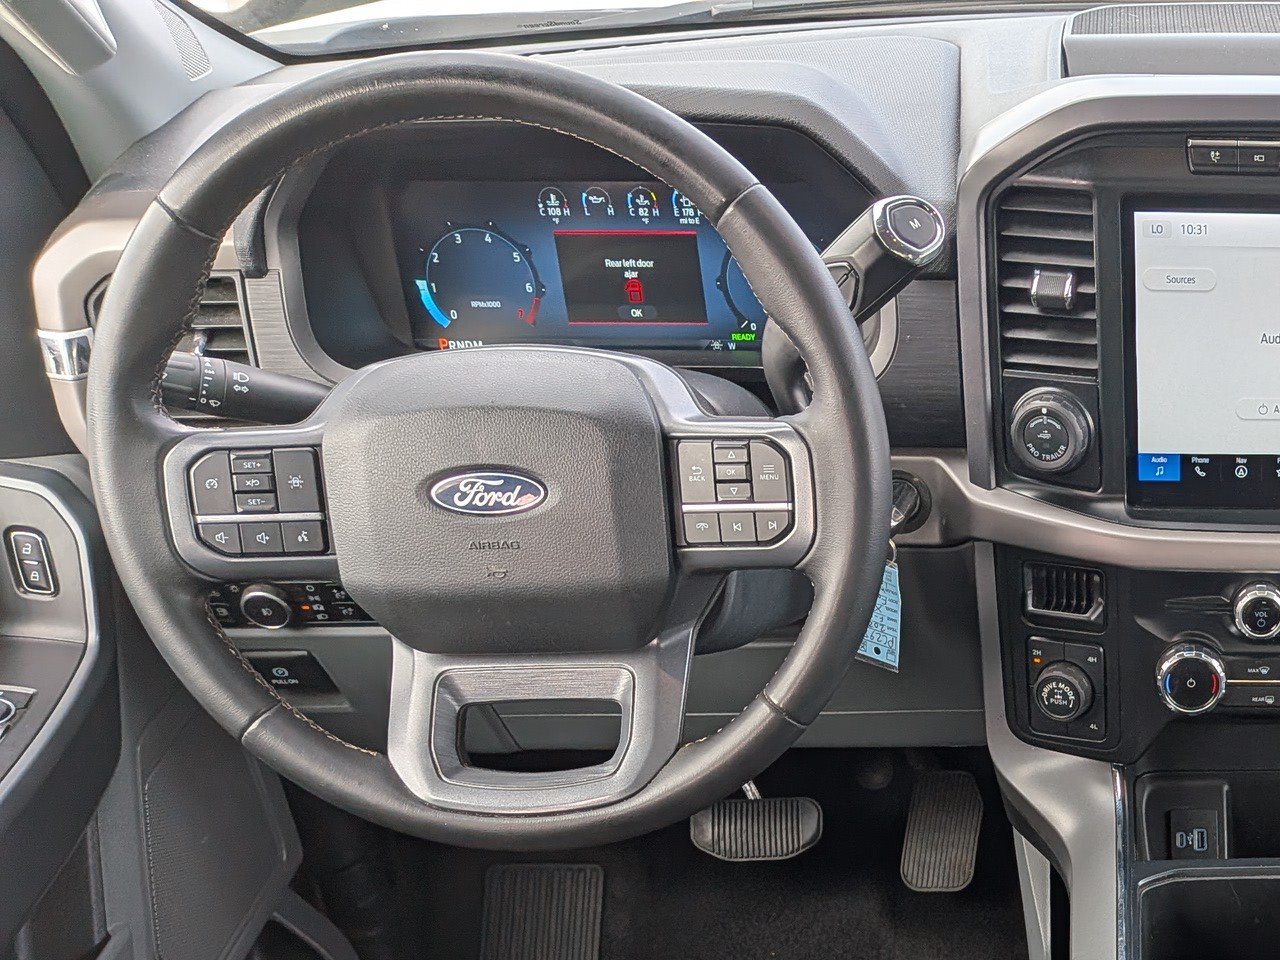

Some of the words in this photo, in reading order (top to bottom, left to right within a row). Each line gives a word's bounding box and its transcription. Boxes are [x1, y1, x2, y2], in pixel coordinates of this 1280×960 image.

[547, 208, 561, 216] 108
[563, 208, 571, 216] H
[607, 208, 615, 216] H
[638, 208, 649, 216] 82
[652, 208, 660, 216] H
[682, 208, 694, 216] 178
[908, 218, 922, 230] M
[1151, 224, 1163, 235] LO
[1180, 224, 1208, 235] 10:31
[454, 233, 462, 244] 3
[484, 233, 492, 244] 4
[432, 252, 440, 263] 2
[513, 252, 520, 262] 5
[604, 258, 622, 268] Rear
[622, 258, 636, 268] left
[636, 258, 654, 268] door
[624, 269, 638, 279] ajar
[1166, 274, 1196, 285] Sources
[430, 282, 437, 293] 1
[525, 282, 533, 293] 6
[450, 309, 458, 320] 0
[630, 308, 643, 318] OK
[731, 333, 755, 341] READY
[1027, 443, 1040, 457] PRO
[1041, 445, 1067, 461] TRAILER
[1191, 456, 1210, 464] Phone
[453, 479, 529, 507] Ford
[468, 541, 521, 550] AIRBAG
[1041, 681, 1057, 699] DRIVE
[1058, 682, 1076, 701] MODE
